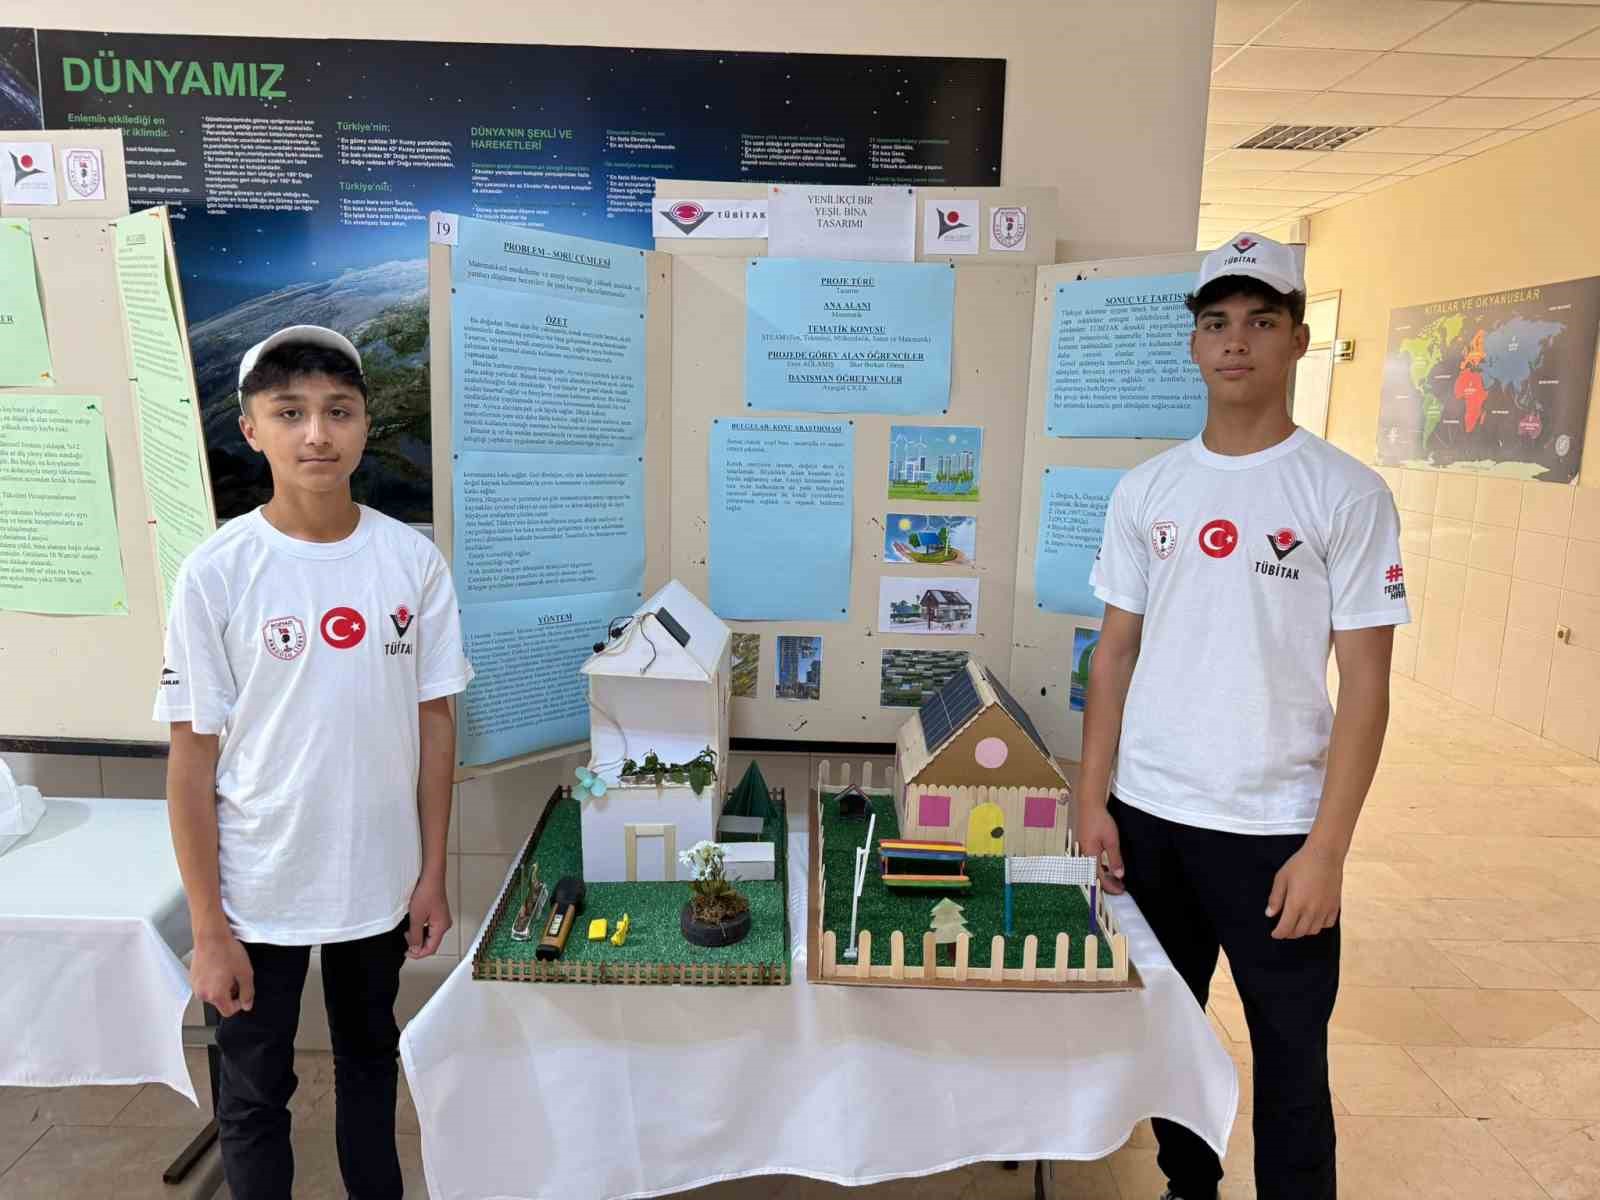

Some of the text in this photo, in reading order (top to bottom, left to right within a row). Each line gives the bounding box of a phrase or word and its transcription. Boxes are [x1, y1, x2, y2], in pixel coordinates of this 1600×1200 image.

[62, 50, 287, 98] DÜNYAMIZ
[68, 113, 105, 123] Enlemin
[107, 114, 151, 126] etkilediği
[338, 121, 390, 132] Türkiye'nin;
[471, 127, 573, 139] DÜNYA'NIN ŞEKLİ VE
[471, 140, 542, 150] HAREKETLERİ
[340, 182, 392, 192] Türkiye'nin;
[808, 192, 873, 205] YENİLİKÇİ BİR
[717, 210, 768, 219] TÜBİTAK
[815, 206, 867, 218] YEŞİL BİNA
[817, 218, 863, 229] TASARIMI
[504, 241, 545, 256] PROBLEM
[553, 249, 575, 261] SORU
[575, 253, 611, 267] CÜMLESİ
[1224, 255, 1257, 265] TÜBİTAK
[821, 277, 874, 286] PROJE TÜRÜ
[1105, 296, 1136, 306] SONUÇ
[1137, 295, 1149, 303] VE
[1461, 297, 1473, 310] VE
[824, 302, 871, 311] ANA ALANI
[545, 313, 568, 326] ÖZET
[808, 324, 886, 334] TEMATİK KONUSU
[768, 350, 925, 362] PROJEDE GÖREV ALAN ÖĞRENCİLER
[788, 373, 903, 384] DANIŞMAN ÖĞRETMENLER
[773, 424, 793, 432] KONU
[795, 424, 841, 433] ARAŞTIRMASI
[1255, 561, 1300, 580] TÜBİTAK
[538, 612, 573, 625] YÖNTEM
